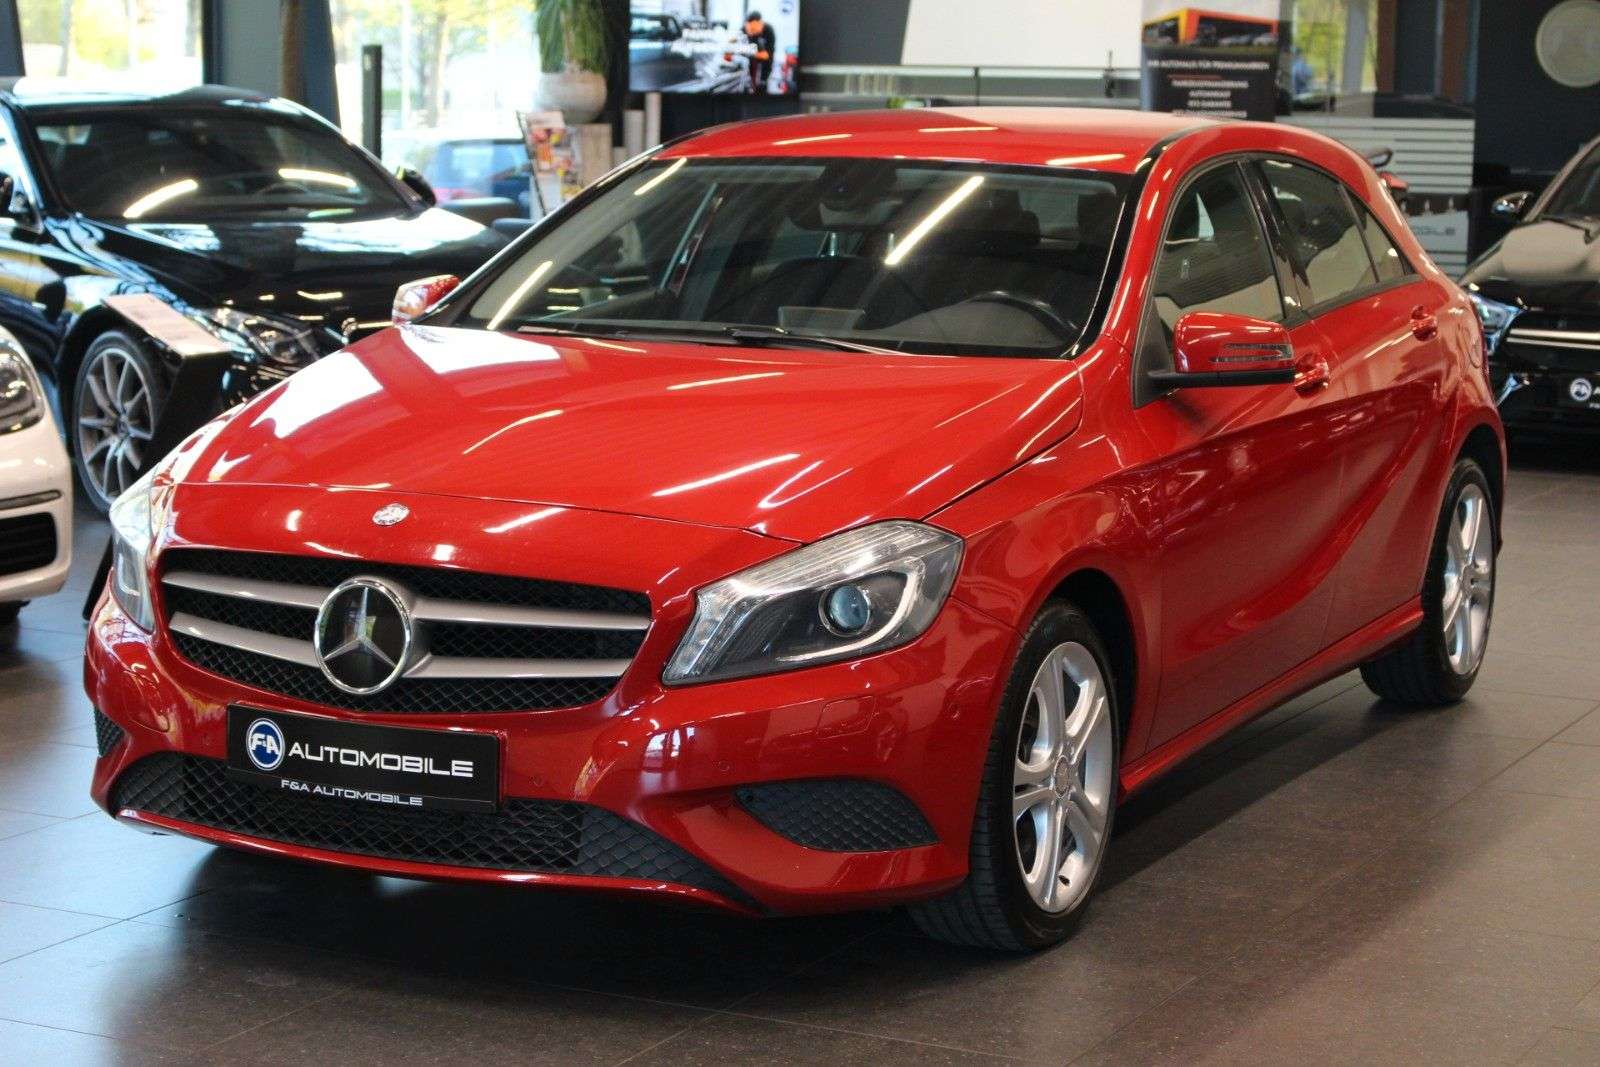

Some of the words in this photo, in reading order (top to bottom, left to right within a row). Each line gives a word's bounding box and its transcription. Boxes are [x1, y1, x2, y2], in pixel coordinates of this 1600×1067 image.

[288, 742, 474, 778] AUTOMOBILE
[281, 779, 310, 792] F&A
[313, 783, 423, 806] AUTOMOBILE
